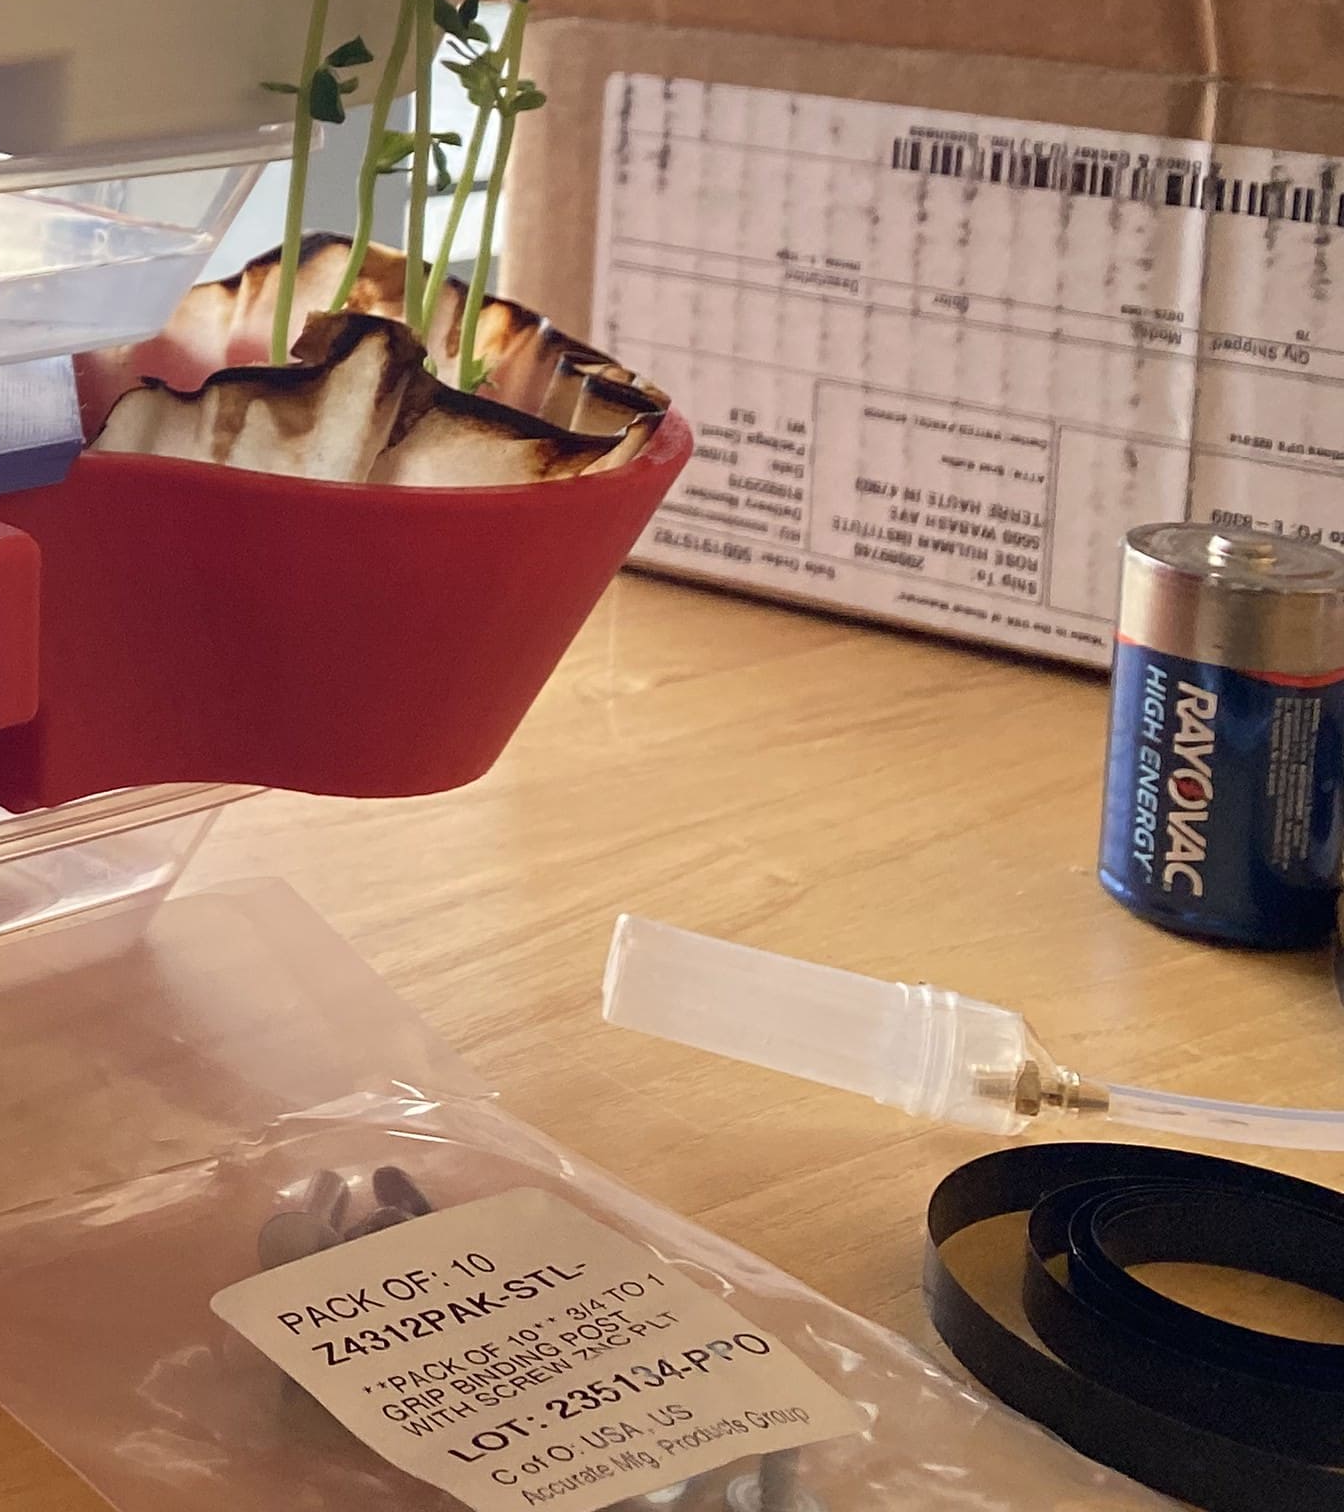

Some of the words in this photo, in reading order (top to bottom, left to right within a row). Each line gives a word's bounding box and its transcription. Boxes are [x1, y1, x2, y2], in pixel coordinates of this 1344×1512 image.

[1212, 337, 1278, 362] Shipped
[831, 515, 912, 546] INSTITUTE
[888, 505, 921, 524] AVE
[926, 515, 997, 541] WABASH
[927, 490, 982, 516] HAUTE
[988, 503, 1043, 528] TERRE
[918, 535, 988, 561] HULMAN
[994, 551, 1039, 573] ROSE
[1002, 573, 1038, 596] Ship
[1143, 664, 1167, 743] HIGH
[1133, 745, 1162, 873] ENERGY
[1163, 681, 1218, 897] RAYOVAC
[278, 1289, 386, 1335] PACK
[382, 1270, 450, 1301] OF:
[451, 1253, 495, 1278] 10
[312, 1263, 586, 1366] Z4312PAK-STL-
[464, 1342, 500, 1365] OF
[566, 1298, 607, 1321] 3/4
[601, 1281, 645, 1302] TO
[647, 1273, 664, 1287] 1
[382, 1388, 445, 1421] GRIP
[450, 1342, 562, 1395] BINDING
[559, 1310, 631, 1347] POST
[402, 1401, 478, 1437] WITH
[475, 1358, 573, 1407] SCREW
[628, 1311, 679, 1337] PLT
[448, 1418, 548, 1463] LOT:
[545, 1334, 770, 1420] 235134-PPO
[491, 1469, 518, 1485] C
[521, 1455, 549, 1474] of
[647, 1405, 693, 1427] US
[522, 1460, 616, 1506] Accurate
[656, 1419, 750, 1456] Products
[744, 1407, 810, 1429] Group
